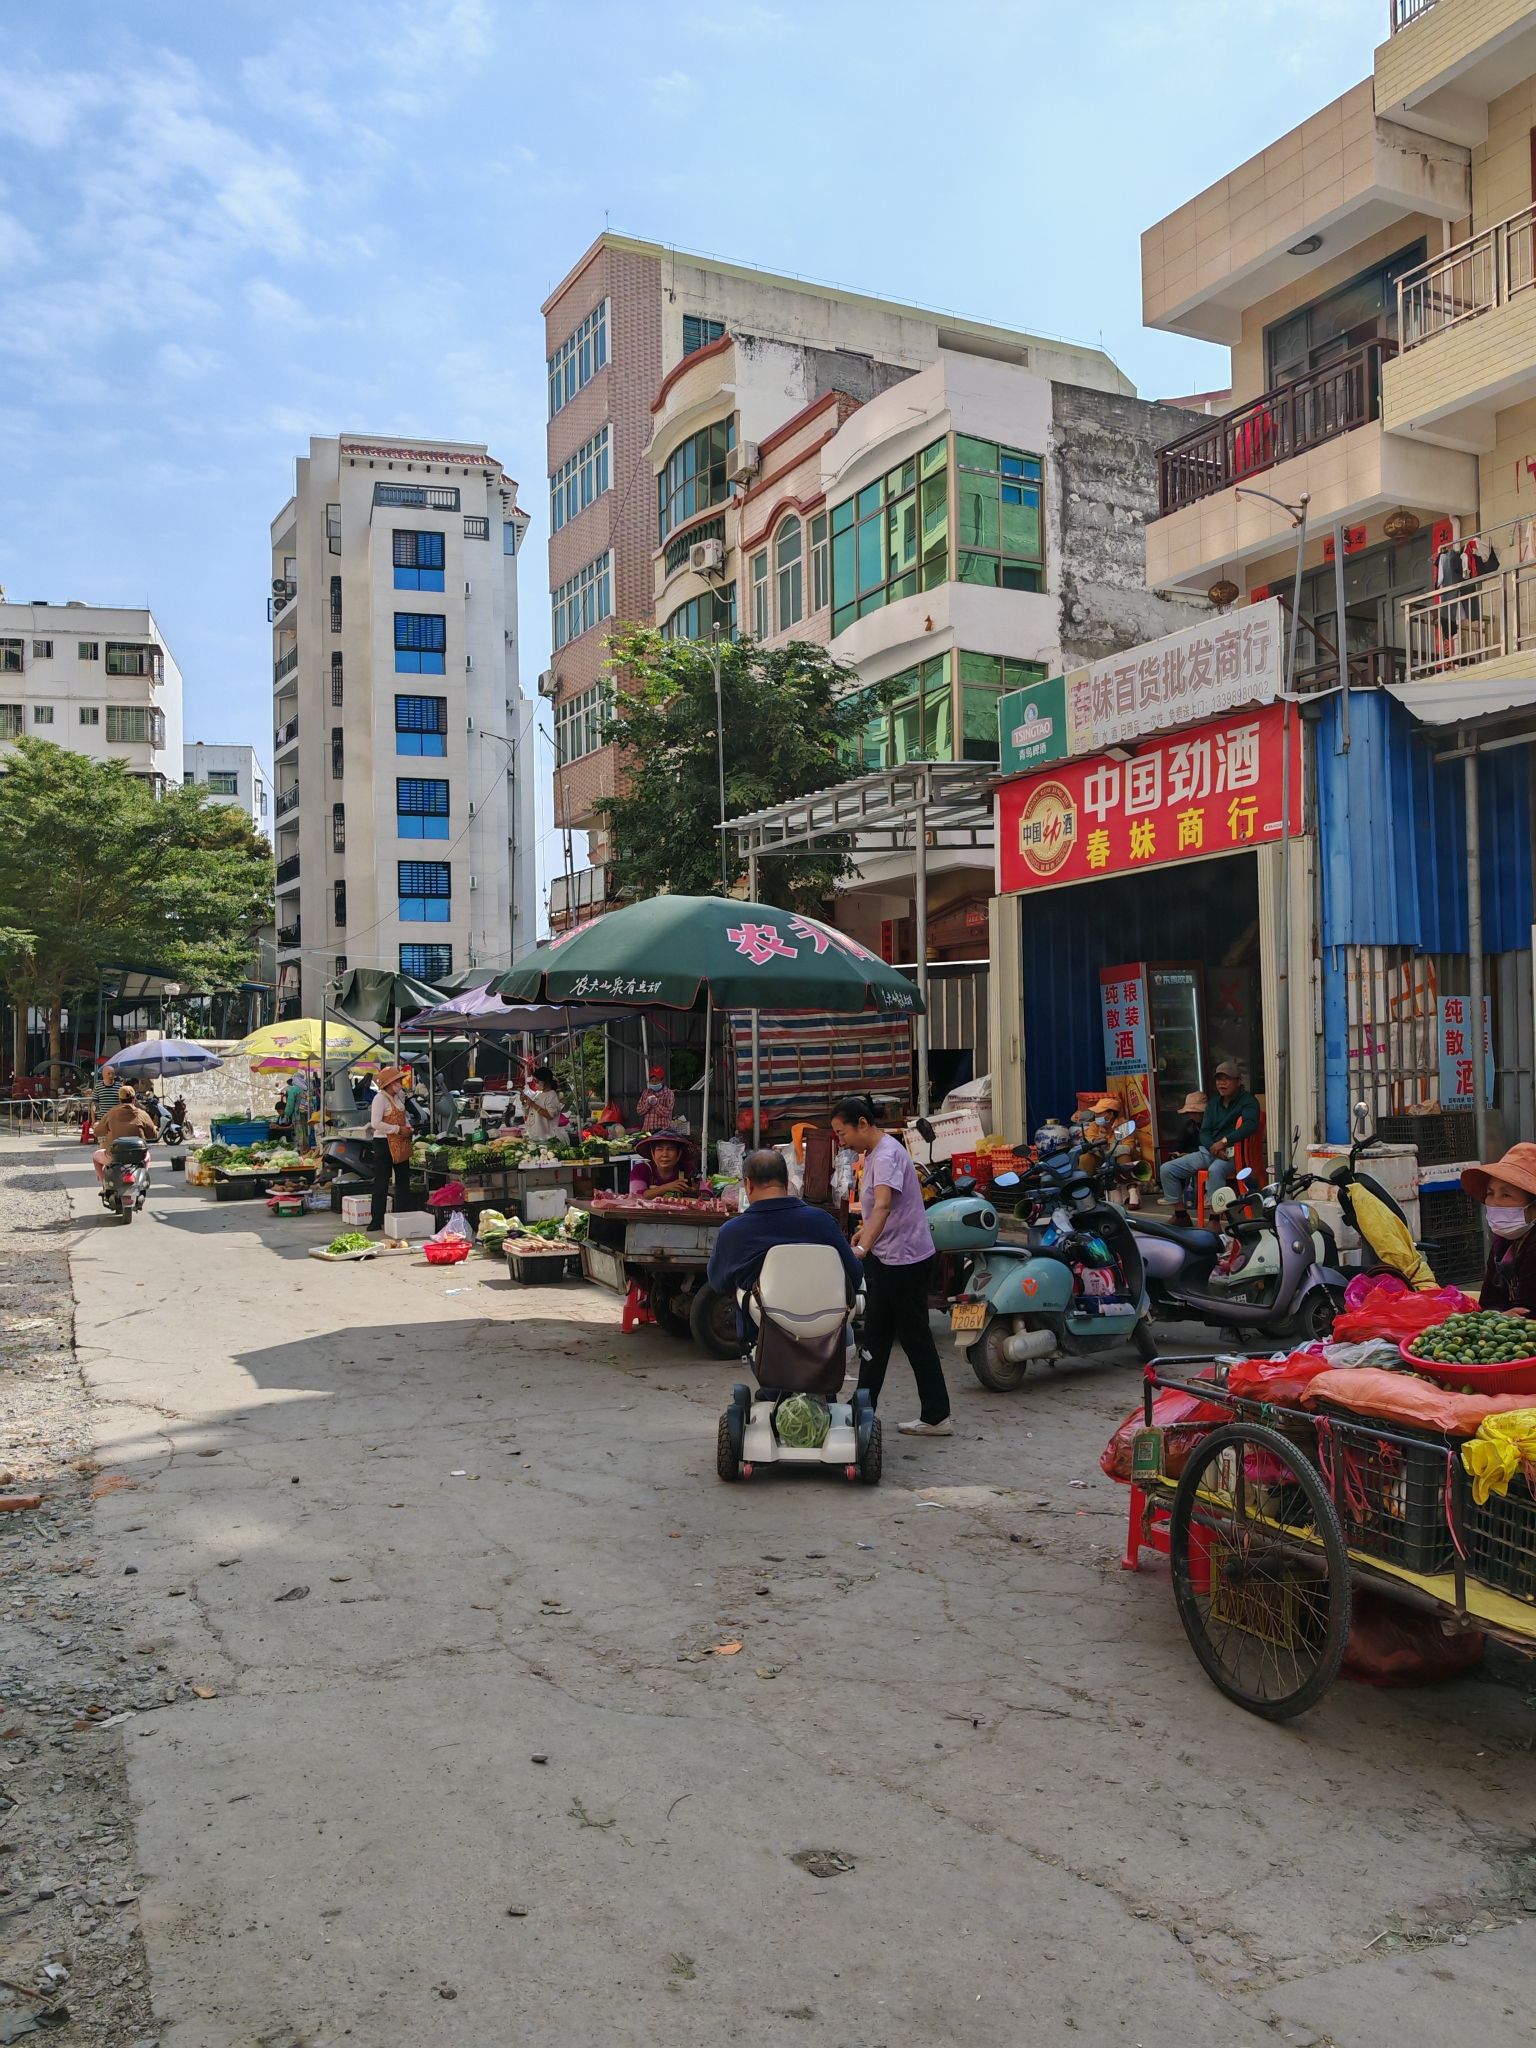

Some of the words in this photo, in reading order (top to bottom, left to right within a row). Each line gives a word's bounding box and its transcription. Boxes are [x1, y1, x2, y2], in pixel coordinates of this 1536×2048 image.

[1014, 722, 1051, 744] TSINGTAO
[1019, 742, 1047, 761] 青岛啤酒
[1084, 721, 1260, 823] 中国劲酒
[1086, 796, 1259, 869] 春妹商行
[569, 974, 662, 997] 农夫山泉有点甜
[1105, 982, 1138, 1005] 纯粮
[1106, 1006, 1139, 1030] 散装
[1114, 1030, 1135, 1059] 酒
